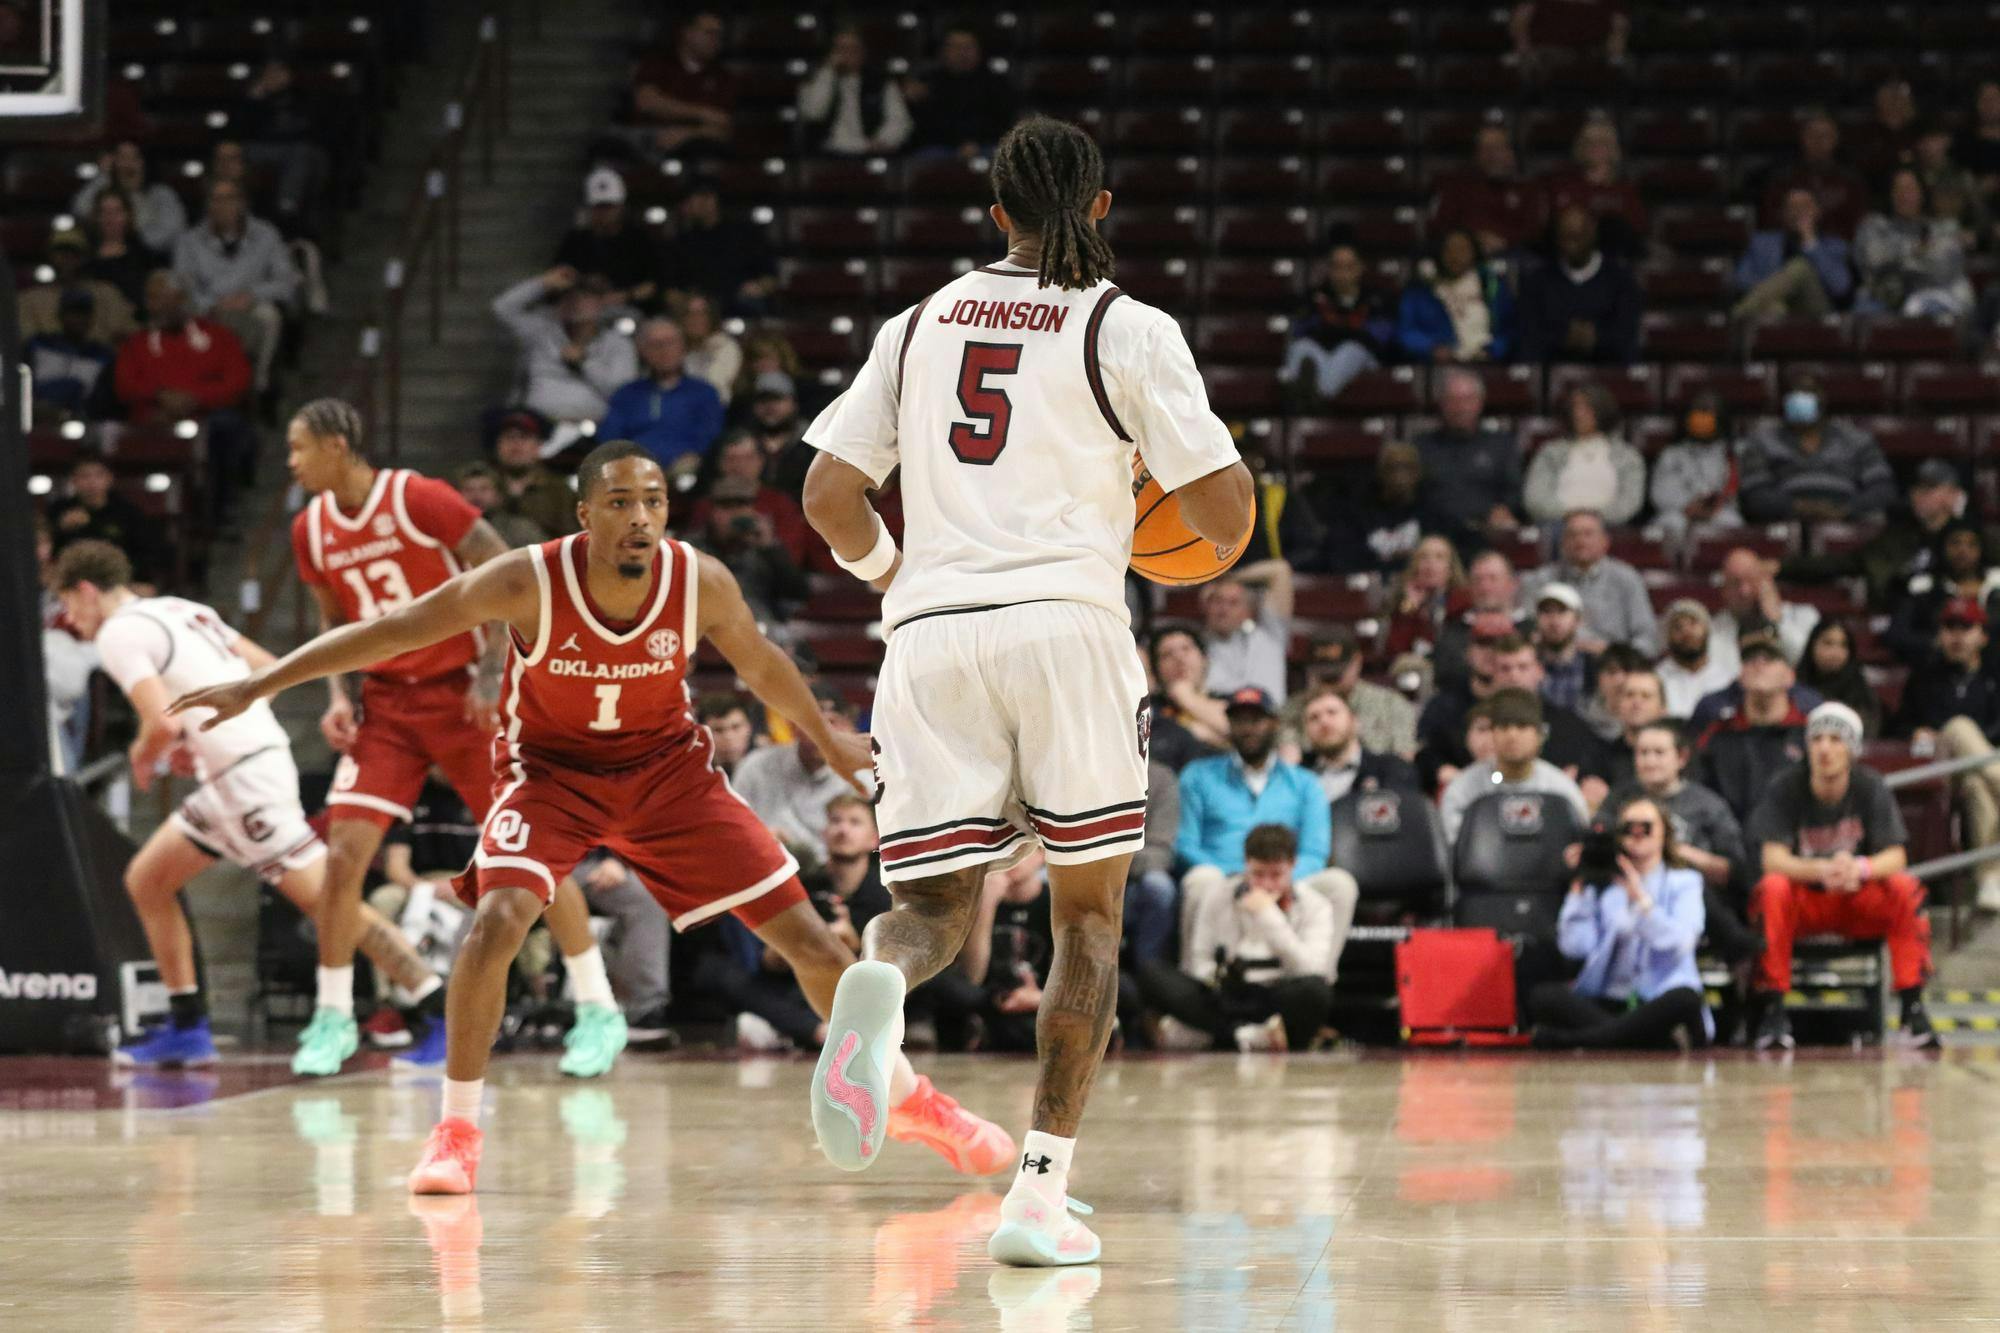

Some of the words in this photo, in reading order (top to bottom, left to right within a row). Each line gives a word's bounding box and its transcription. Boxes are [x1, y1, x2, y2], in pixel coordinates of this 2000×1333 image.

[938, 299, 1069, 333] JOHNSON
[948, 340, 1024, 466] 5
[342, 558, 414, 620] 13
[648, 630, 680, 658] SEC
[548, 658, 676, 680] OKLAHOMA
[588, 684, 623, 732] 1
[490, 808, 531, 853] OU
